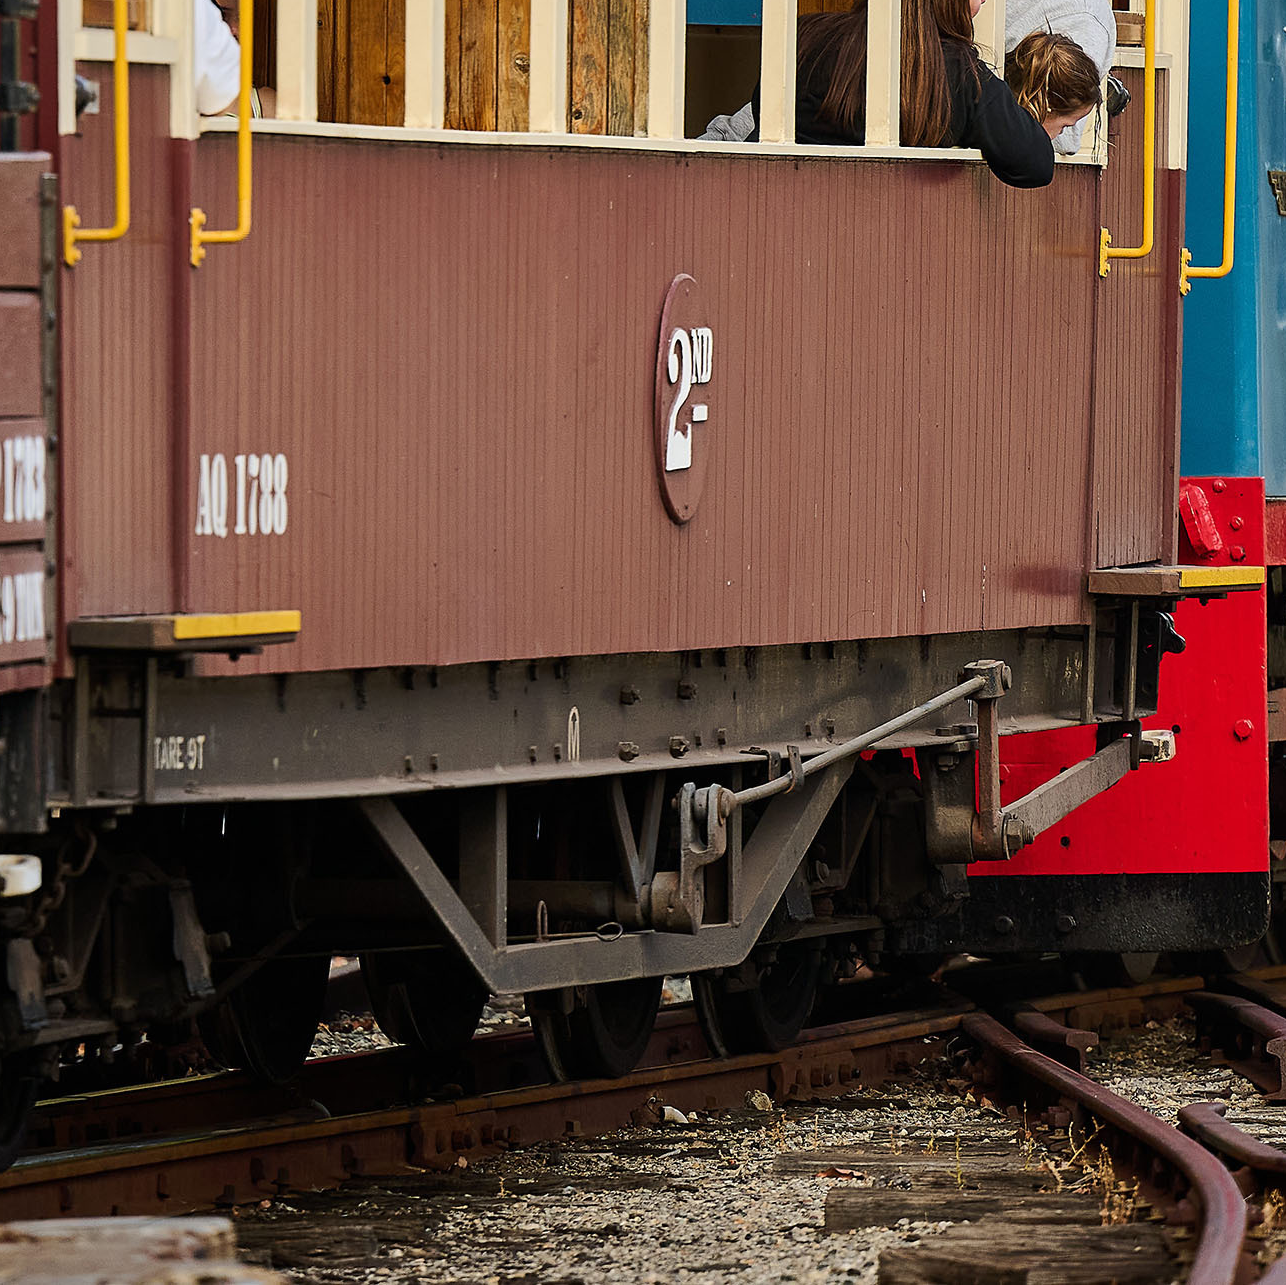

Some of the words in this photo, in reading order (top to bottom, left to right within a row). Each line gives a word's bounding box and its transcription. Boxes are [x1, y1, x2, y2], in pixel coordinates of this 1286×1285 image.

[195, 453, 228, 539] AQ
[234, 453, 288, 536] 1788
[154, 736, 184, 770] TARE
